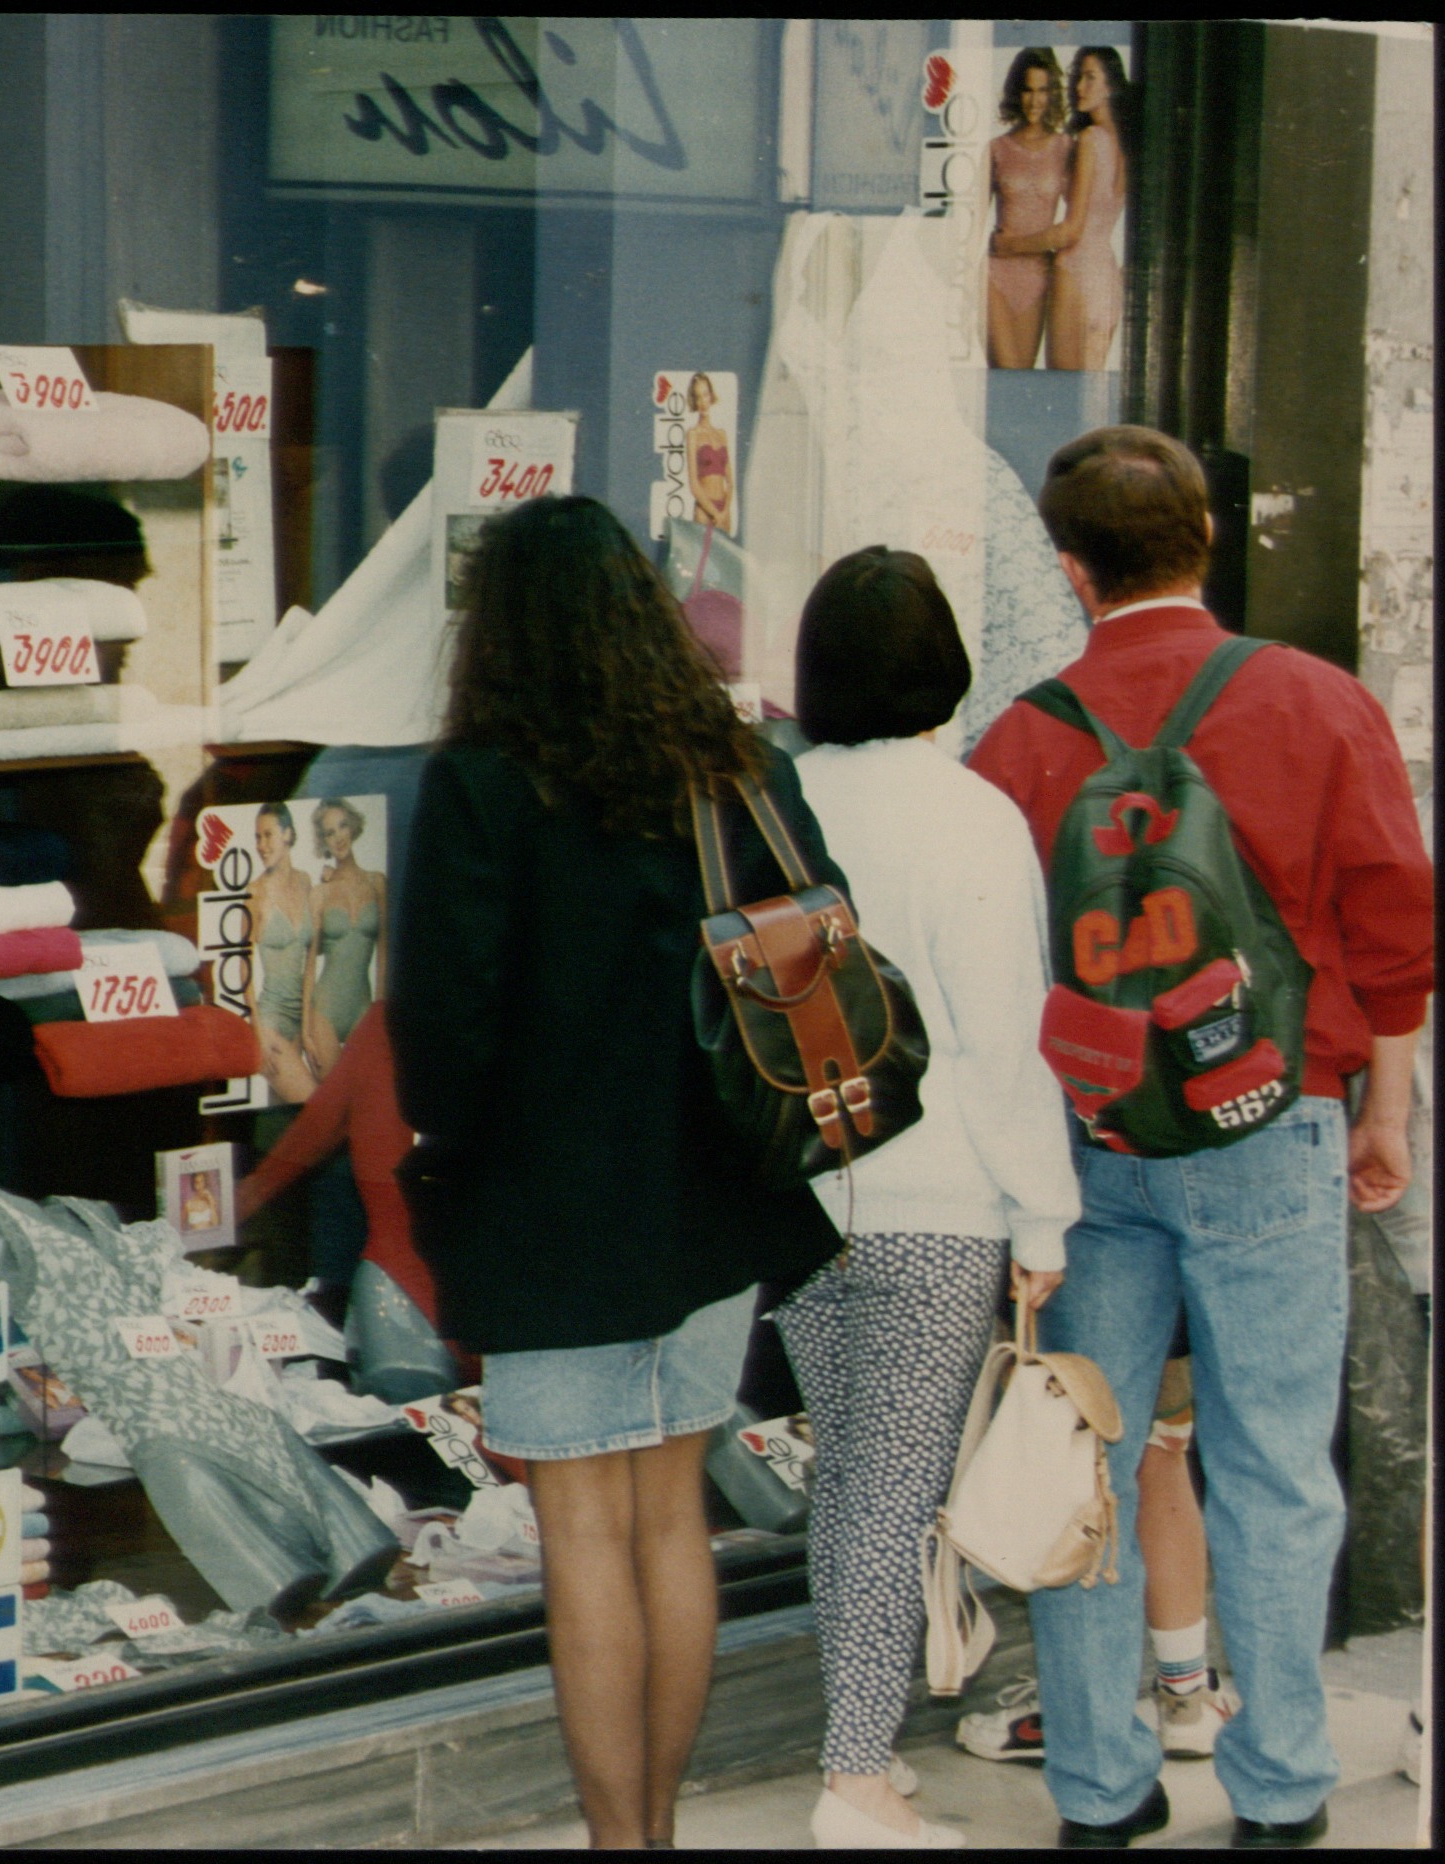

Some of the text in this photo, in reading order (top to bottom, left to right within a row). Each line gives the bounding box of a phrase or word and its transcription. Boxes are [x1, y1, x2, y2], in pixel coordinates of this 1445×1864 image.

[480, 458, 554, 499] 3400
[658, 391, 687, 540] ovable
[202, 846, 253, 1110] Lvable
